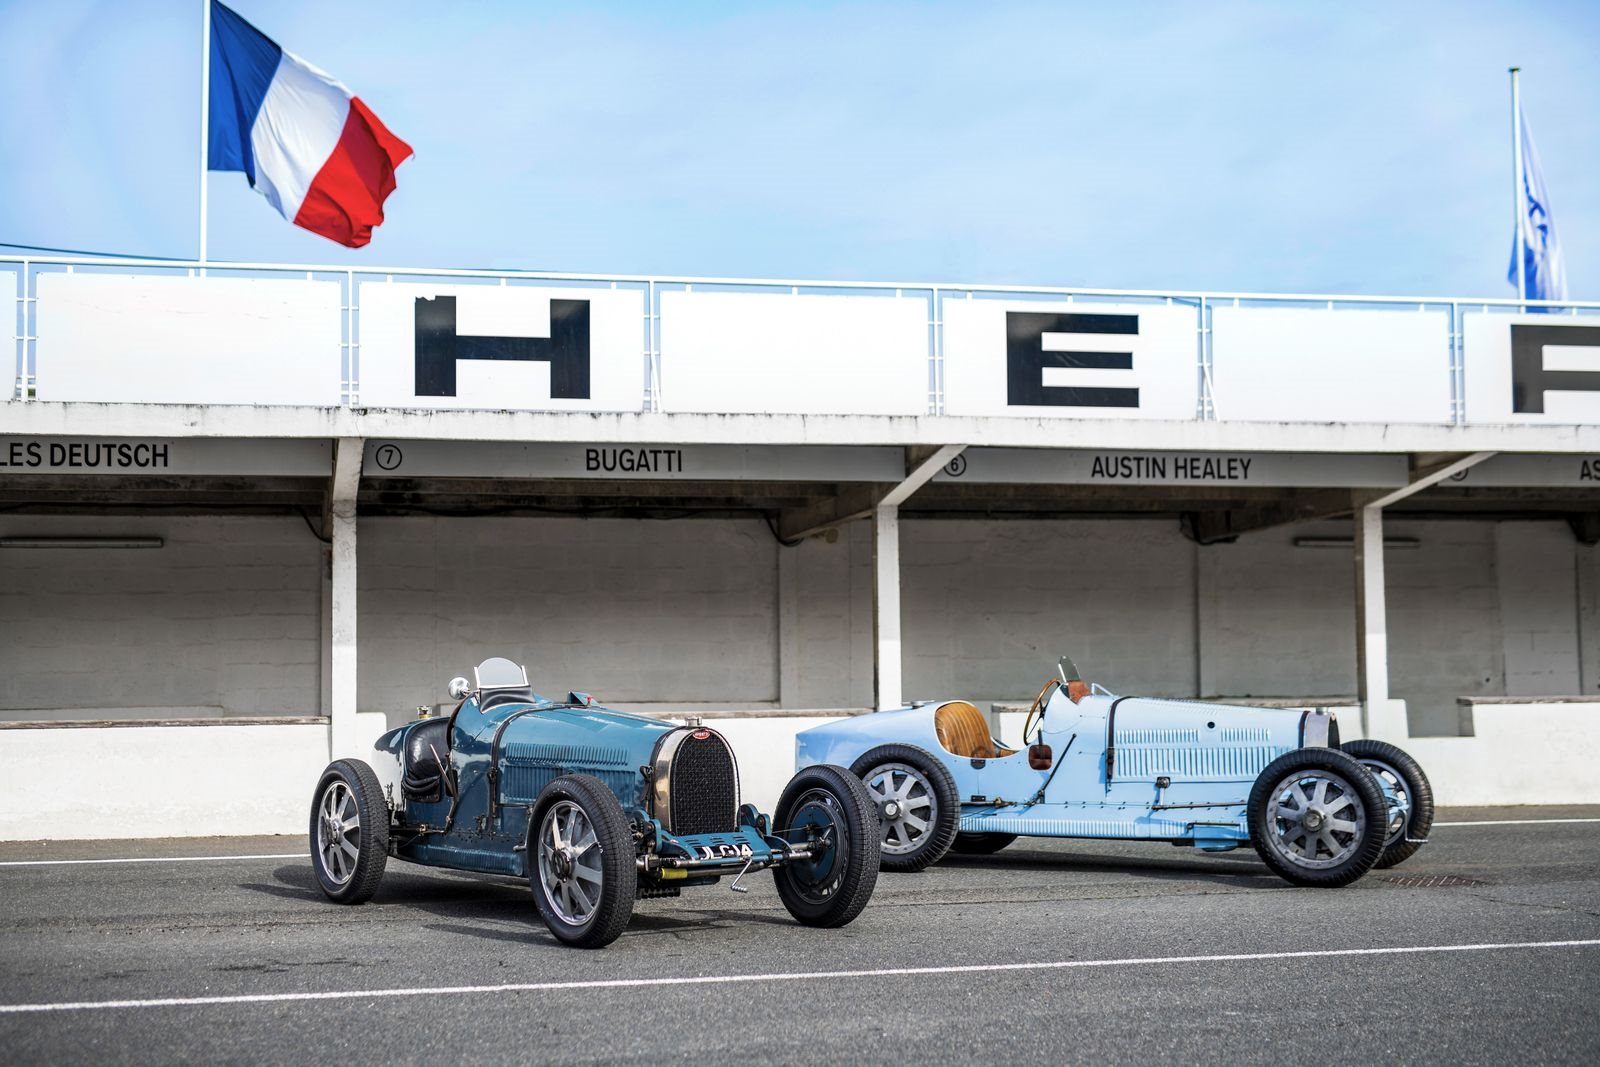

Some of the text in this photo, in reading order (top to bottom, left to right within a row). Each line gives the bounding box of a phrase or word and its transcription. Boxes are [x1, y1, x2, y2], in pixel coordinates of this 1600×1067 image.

[414, 295, 591, 399] H
[1005, 311, 1140, 409] E
[49, 443, 169, 468] DEUTSCH
[585, 448, 682, 473] BUGATTI
[1091, 456, 1252, 480] AUSTIN HEALEY
